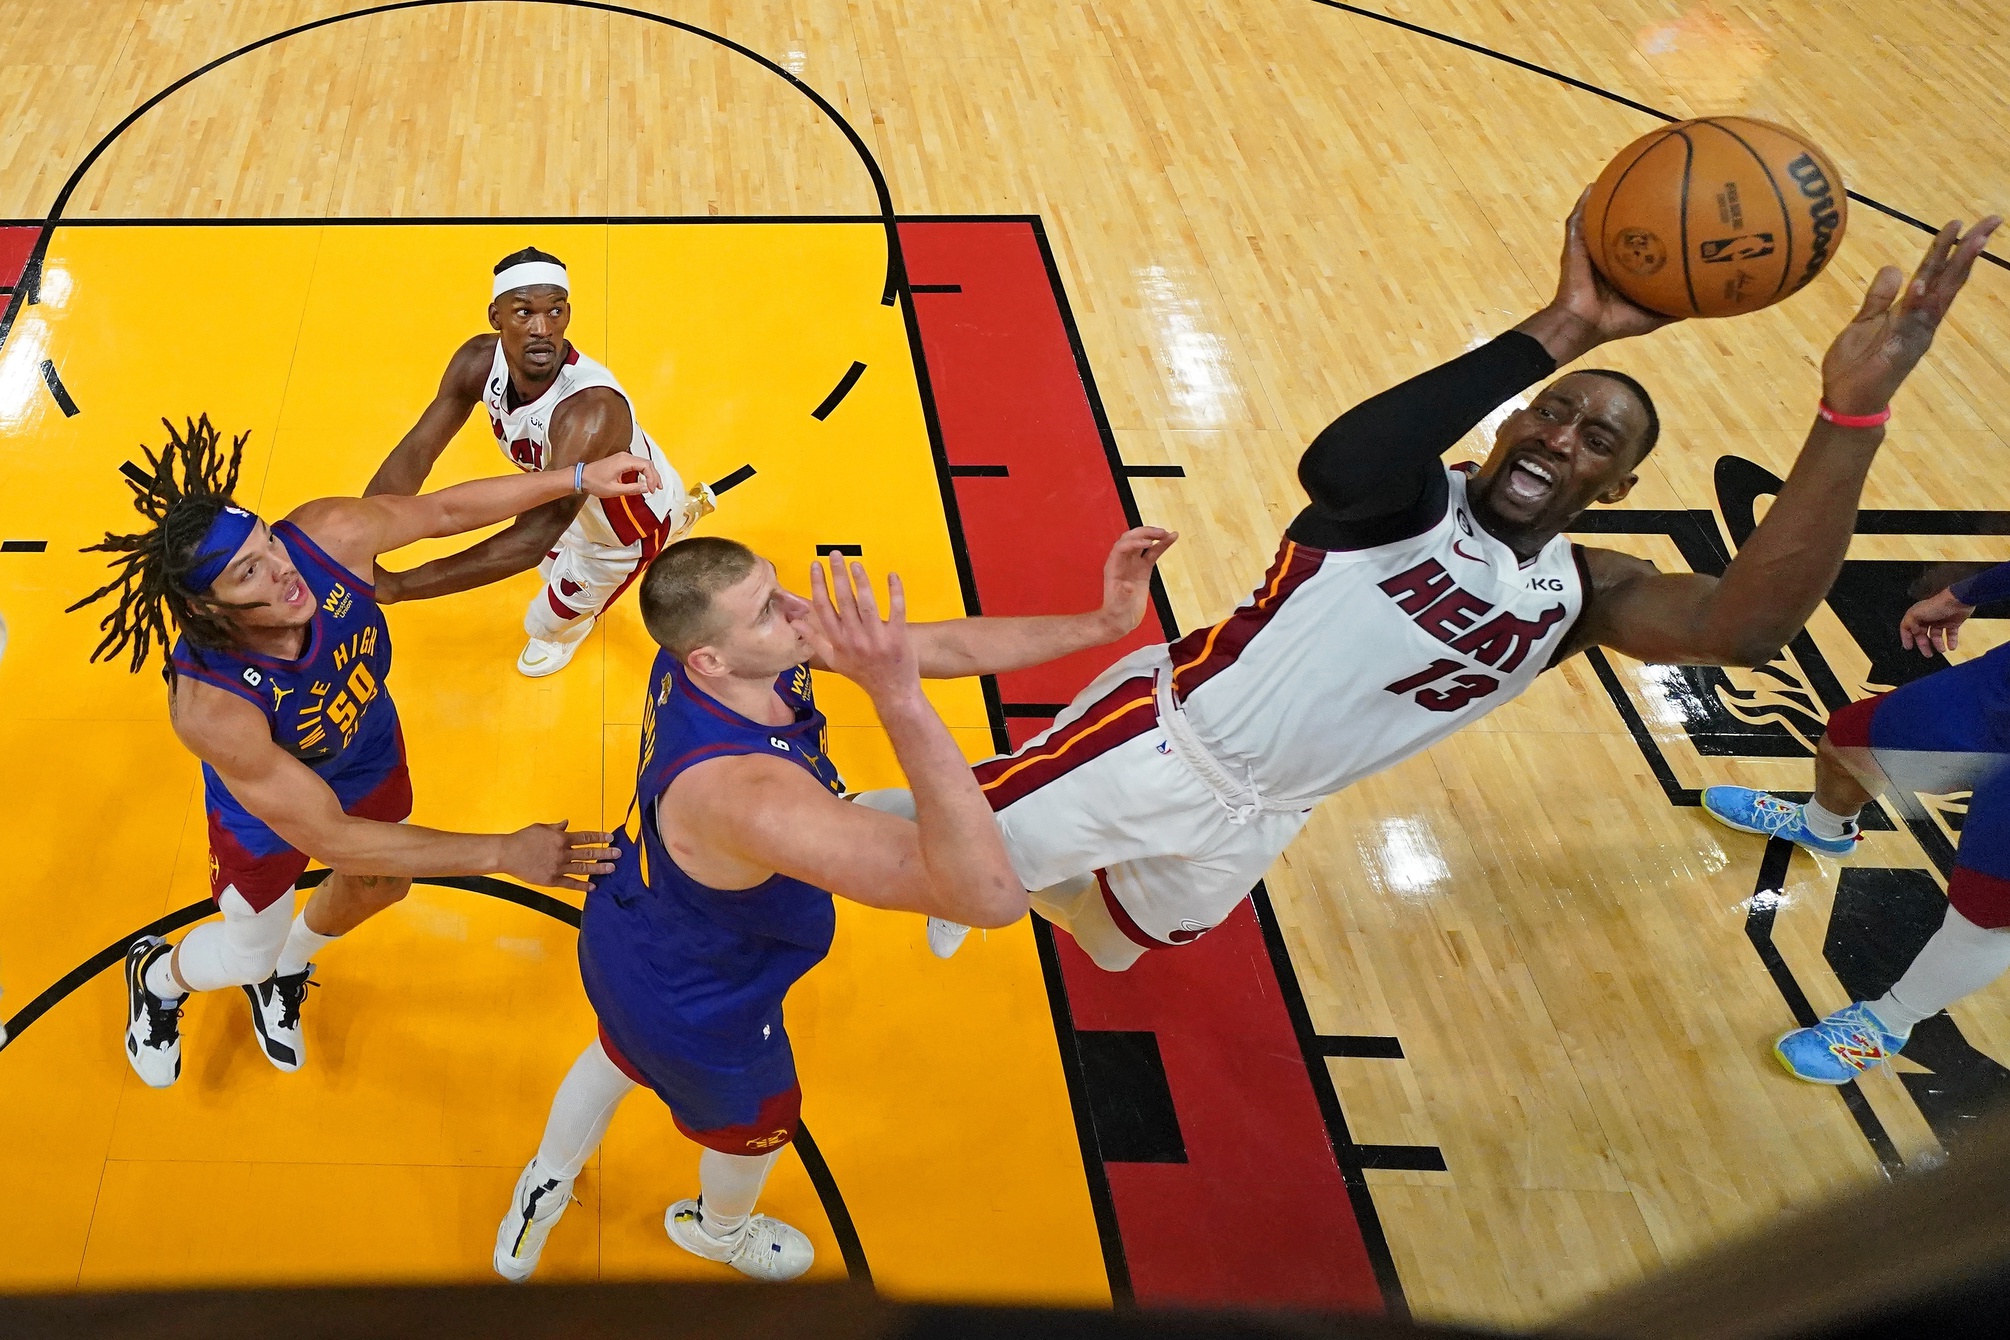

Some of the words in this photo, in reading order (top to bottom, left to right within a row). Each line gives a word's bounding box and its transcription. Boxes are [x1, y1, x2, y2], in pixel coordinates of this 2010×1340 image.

[323, 582, 346, 613] WU
[1526, 577, 1564, 592] KG
[1376, 556, 1567, 674] HEAT
[242, 667, 263, 688] 6
[1383, 658, 1500, 713] 13
[326, 661, 376, 734] 50
[770, 736, 790, 752] 6
